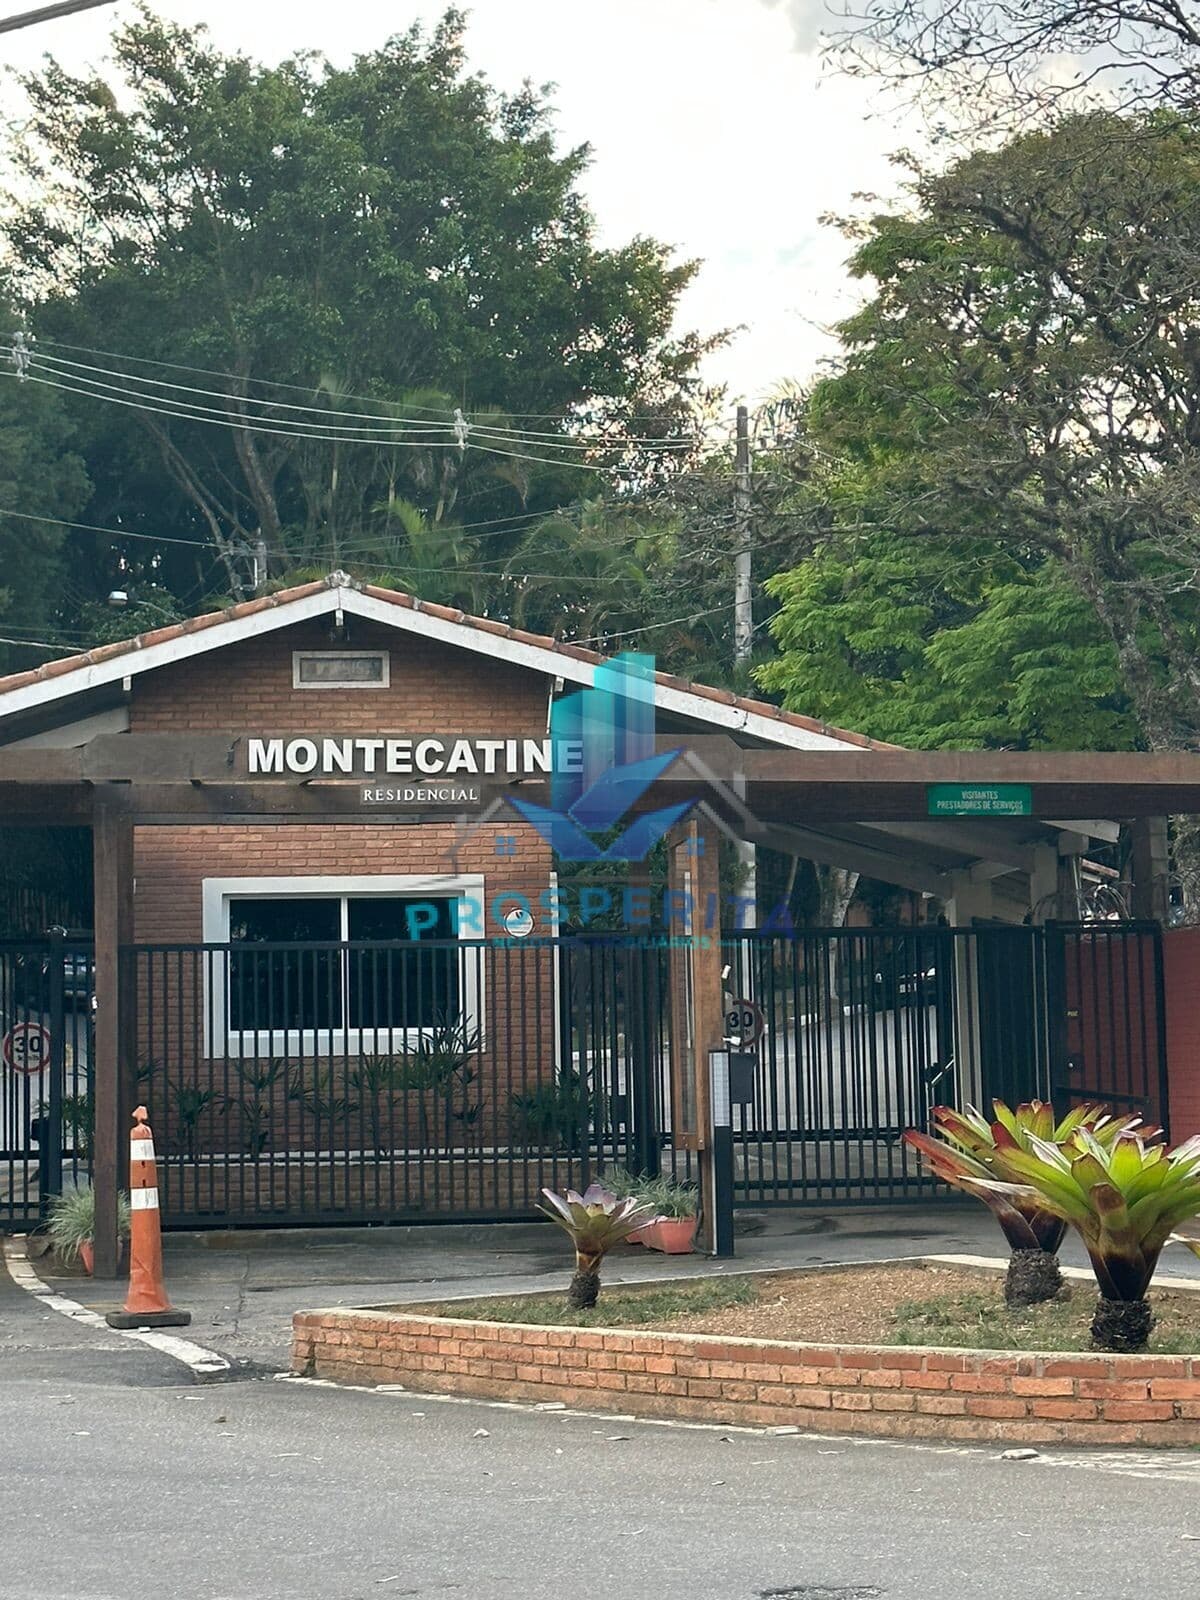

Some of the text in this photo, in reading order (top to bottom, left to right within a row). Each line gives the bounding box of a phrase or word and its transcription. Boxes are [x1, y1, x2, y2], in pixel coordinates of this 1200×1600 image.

[248, 738, 584, 774] MONTECATINE
[363, 788, 478, 802] RESIDENCIAL
[961, 791, 999, 800] VISITANTES
[937, 801, 1023, 810] PRESTADORES DE SERVIÇOS
[728, 1011, 753, 1028] 30
[14, 1036, 40, 1053] 30
